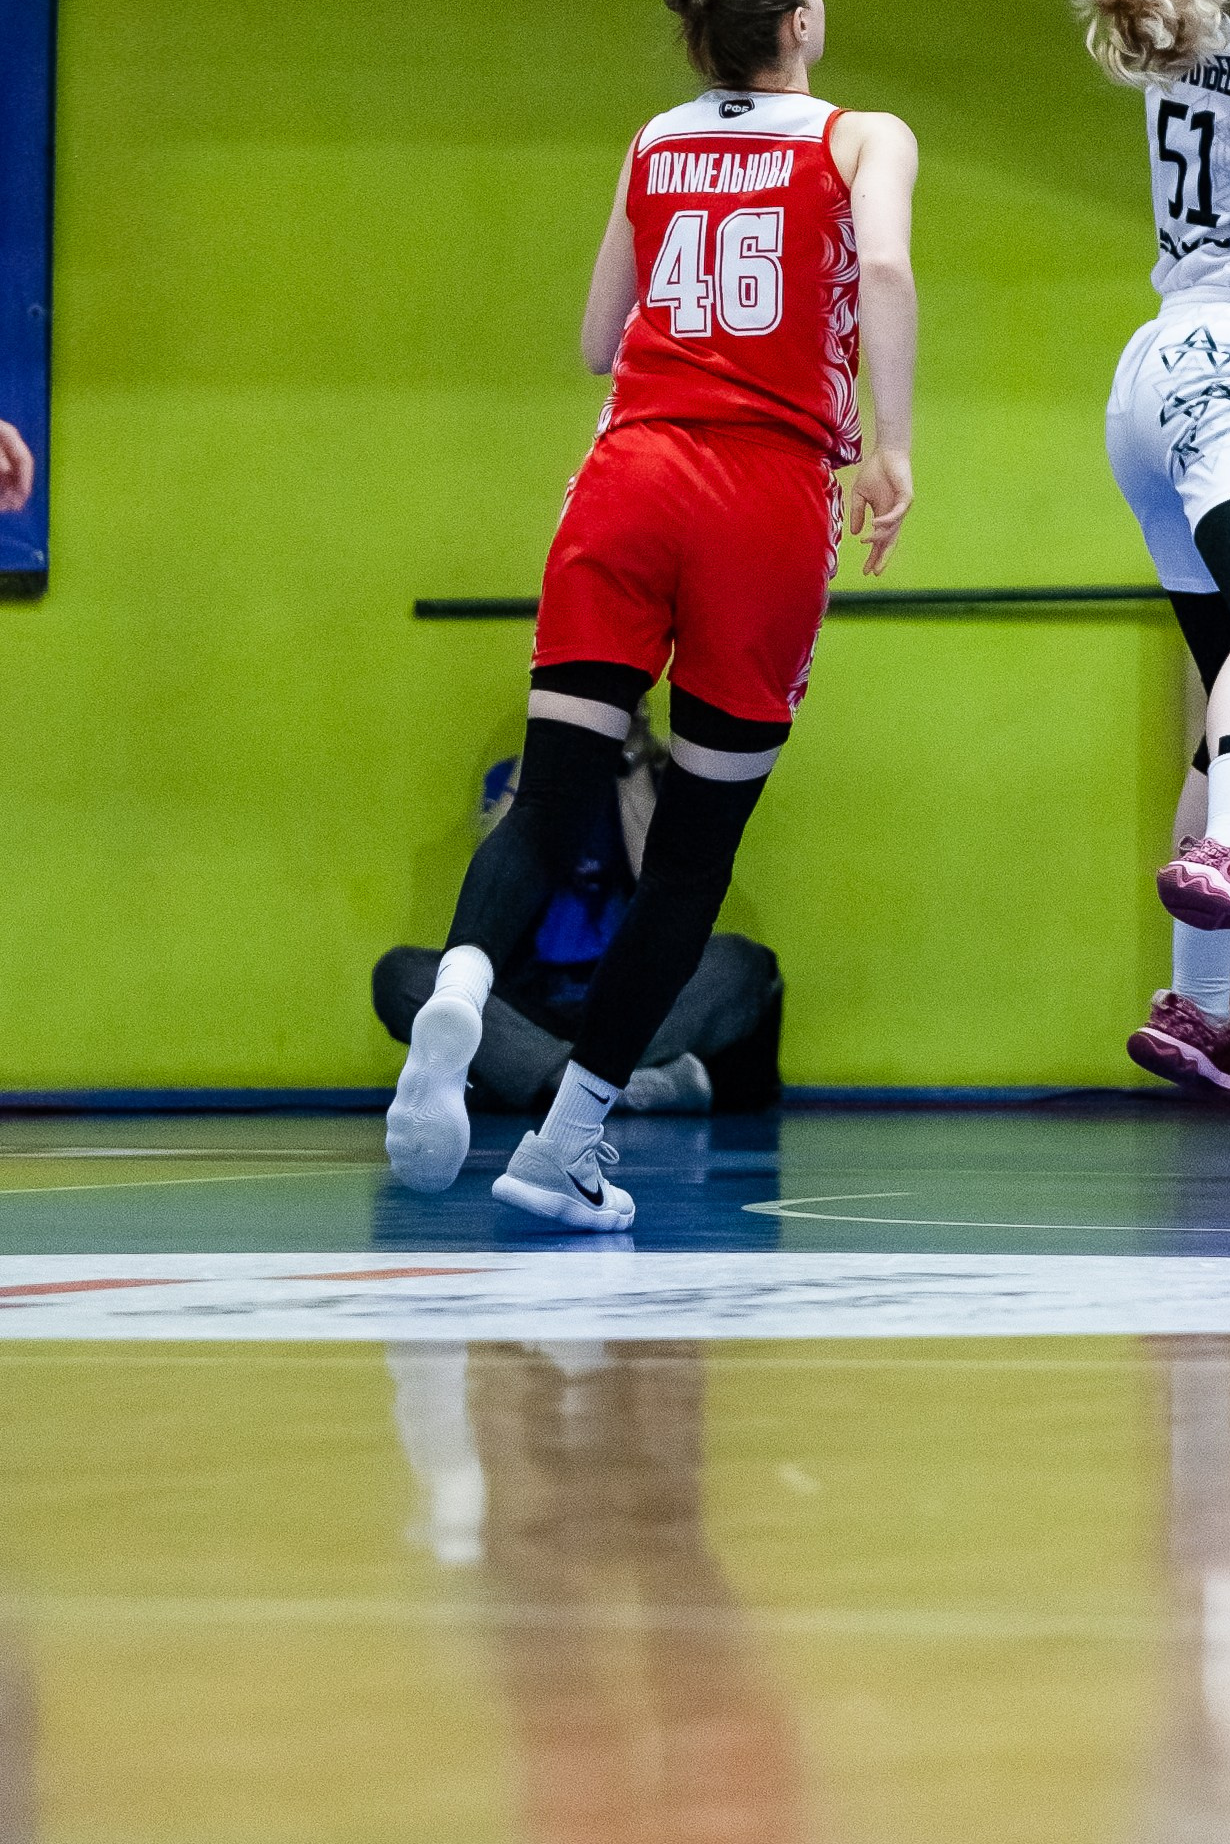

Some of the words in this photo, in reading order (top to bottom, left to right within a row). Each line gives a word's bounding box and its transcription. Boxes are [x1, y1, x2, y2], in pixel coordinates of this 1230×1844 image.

[646, 150, 794, 195] ПОХМЕЛЬНОВА
[1158, 98, 1222, 229] 51
[646, 206, 785, 338] 46
